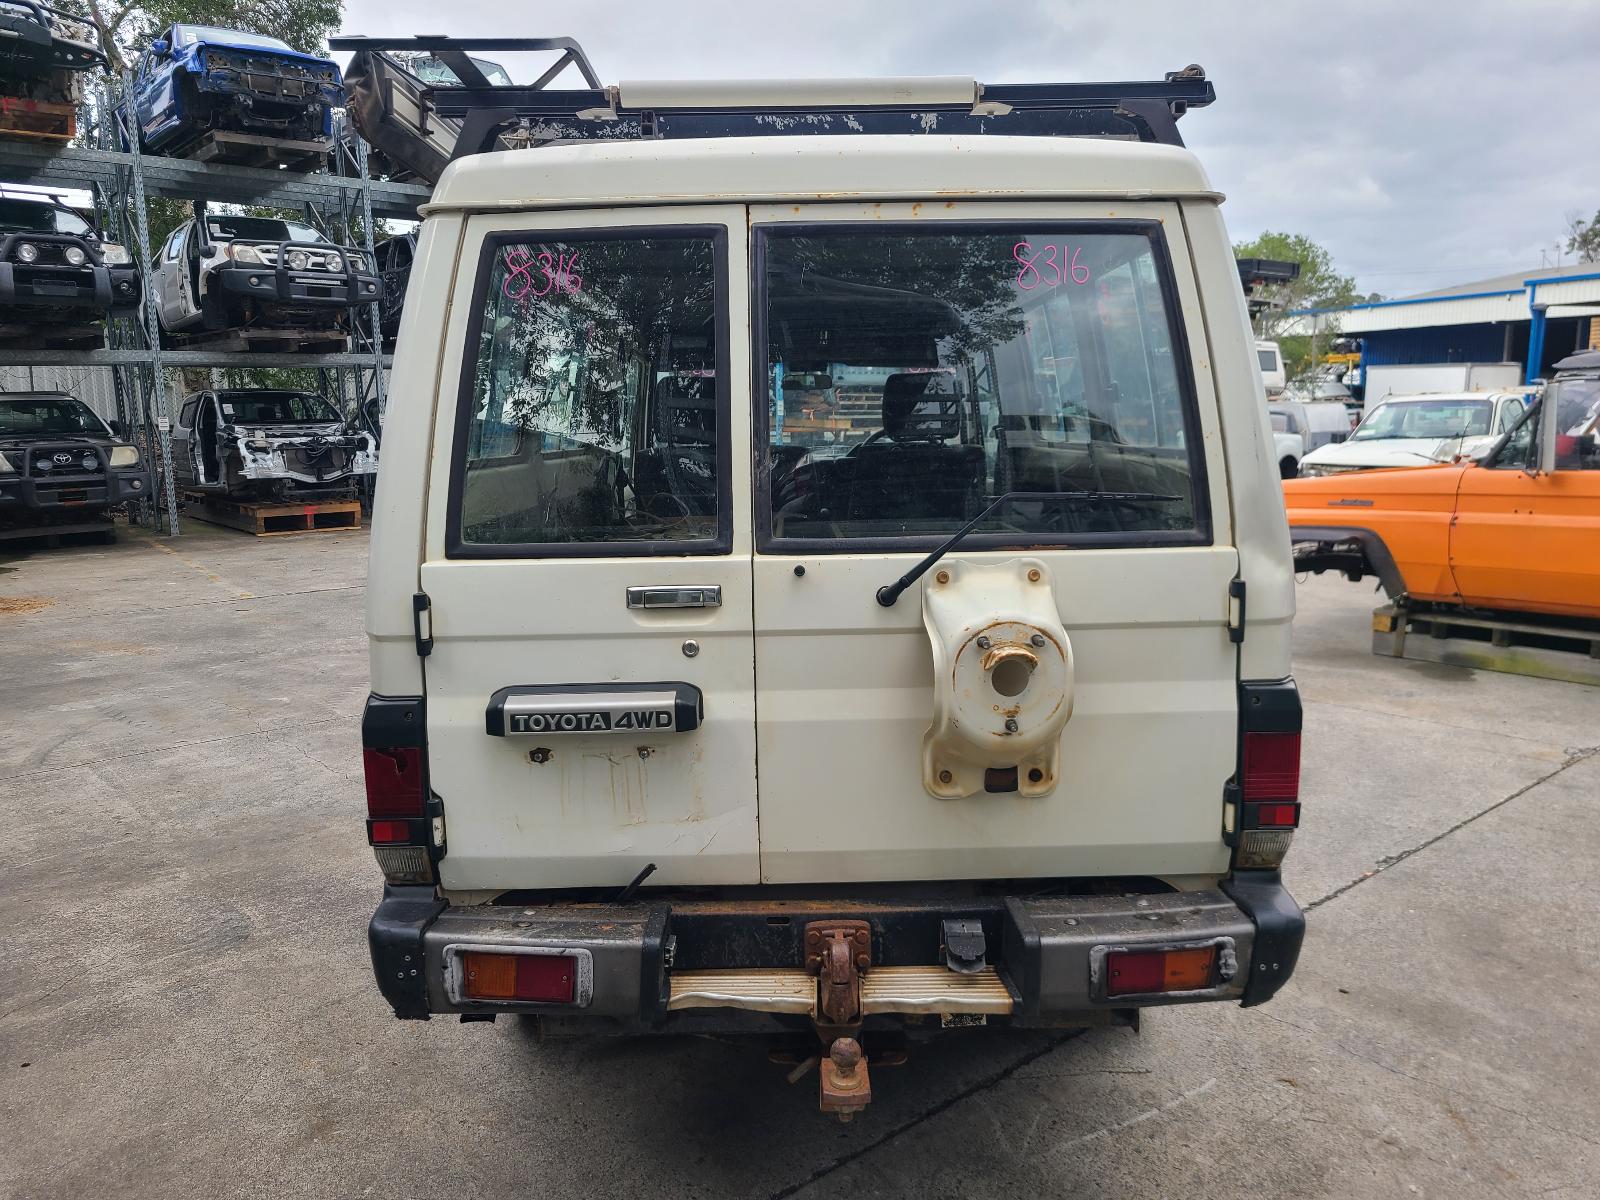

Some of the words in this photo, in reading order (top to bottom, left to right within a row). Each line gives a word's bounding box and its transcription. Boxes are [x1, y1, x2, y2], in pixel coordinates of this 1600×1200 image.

[504, 250, 582, 299] 8316
[1013, 242, 1090, 290] 8316
[515, 713, 606, 731] TOYOTA
[614, 711, 673, 730] 4WD
